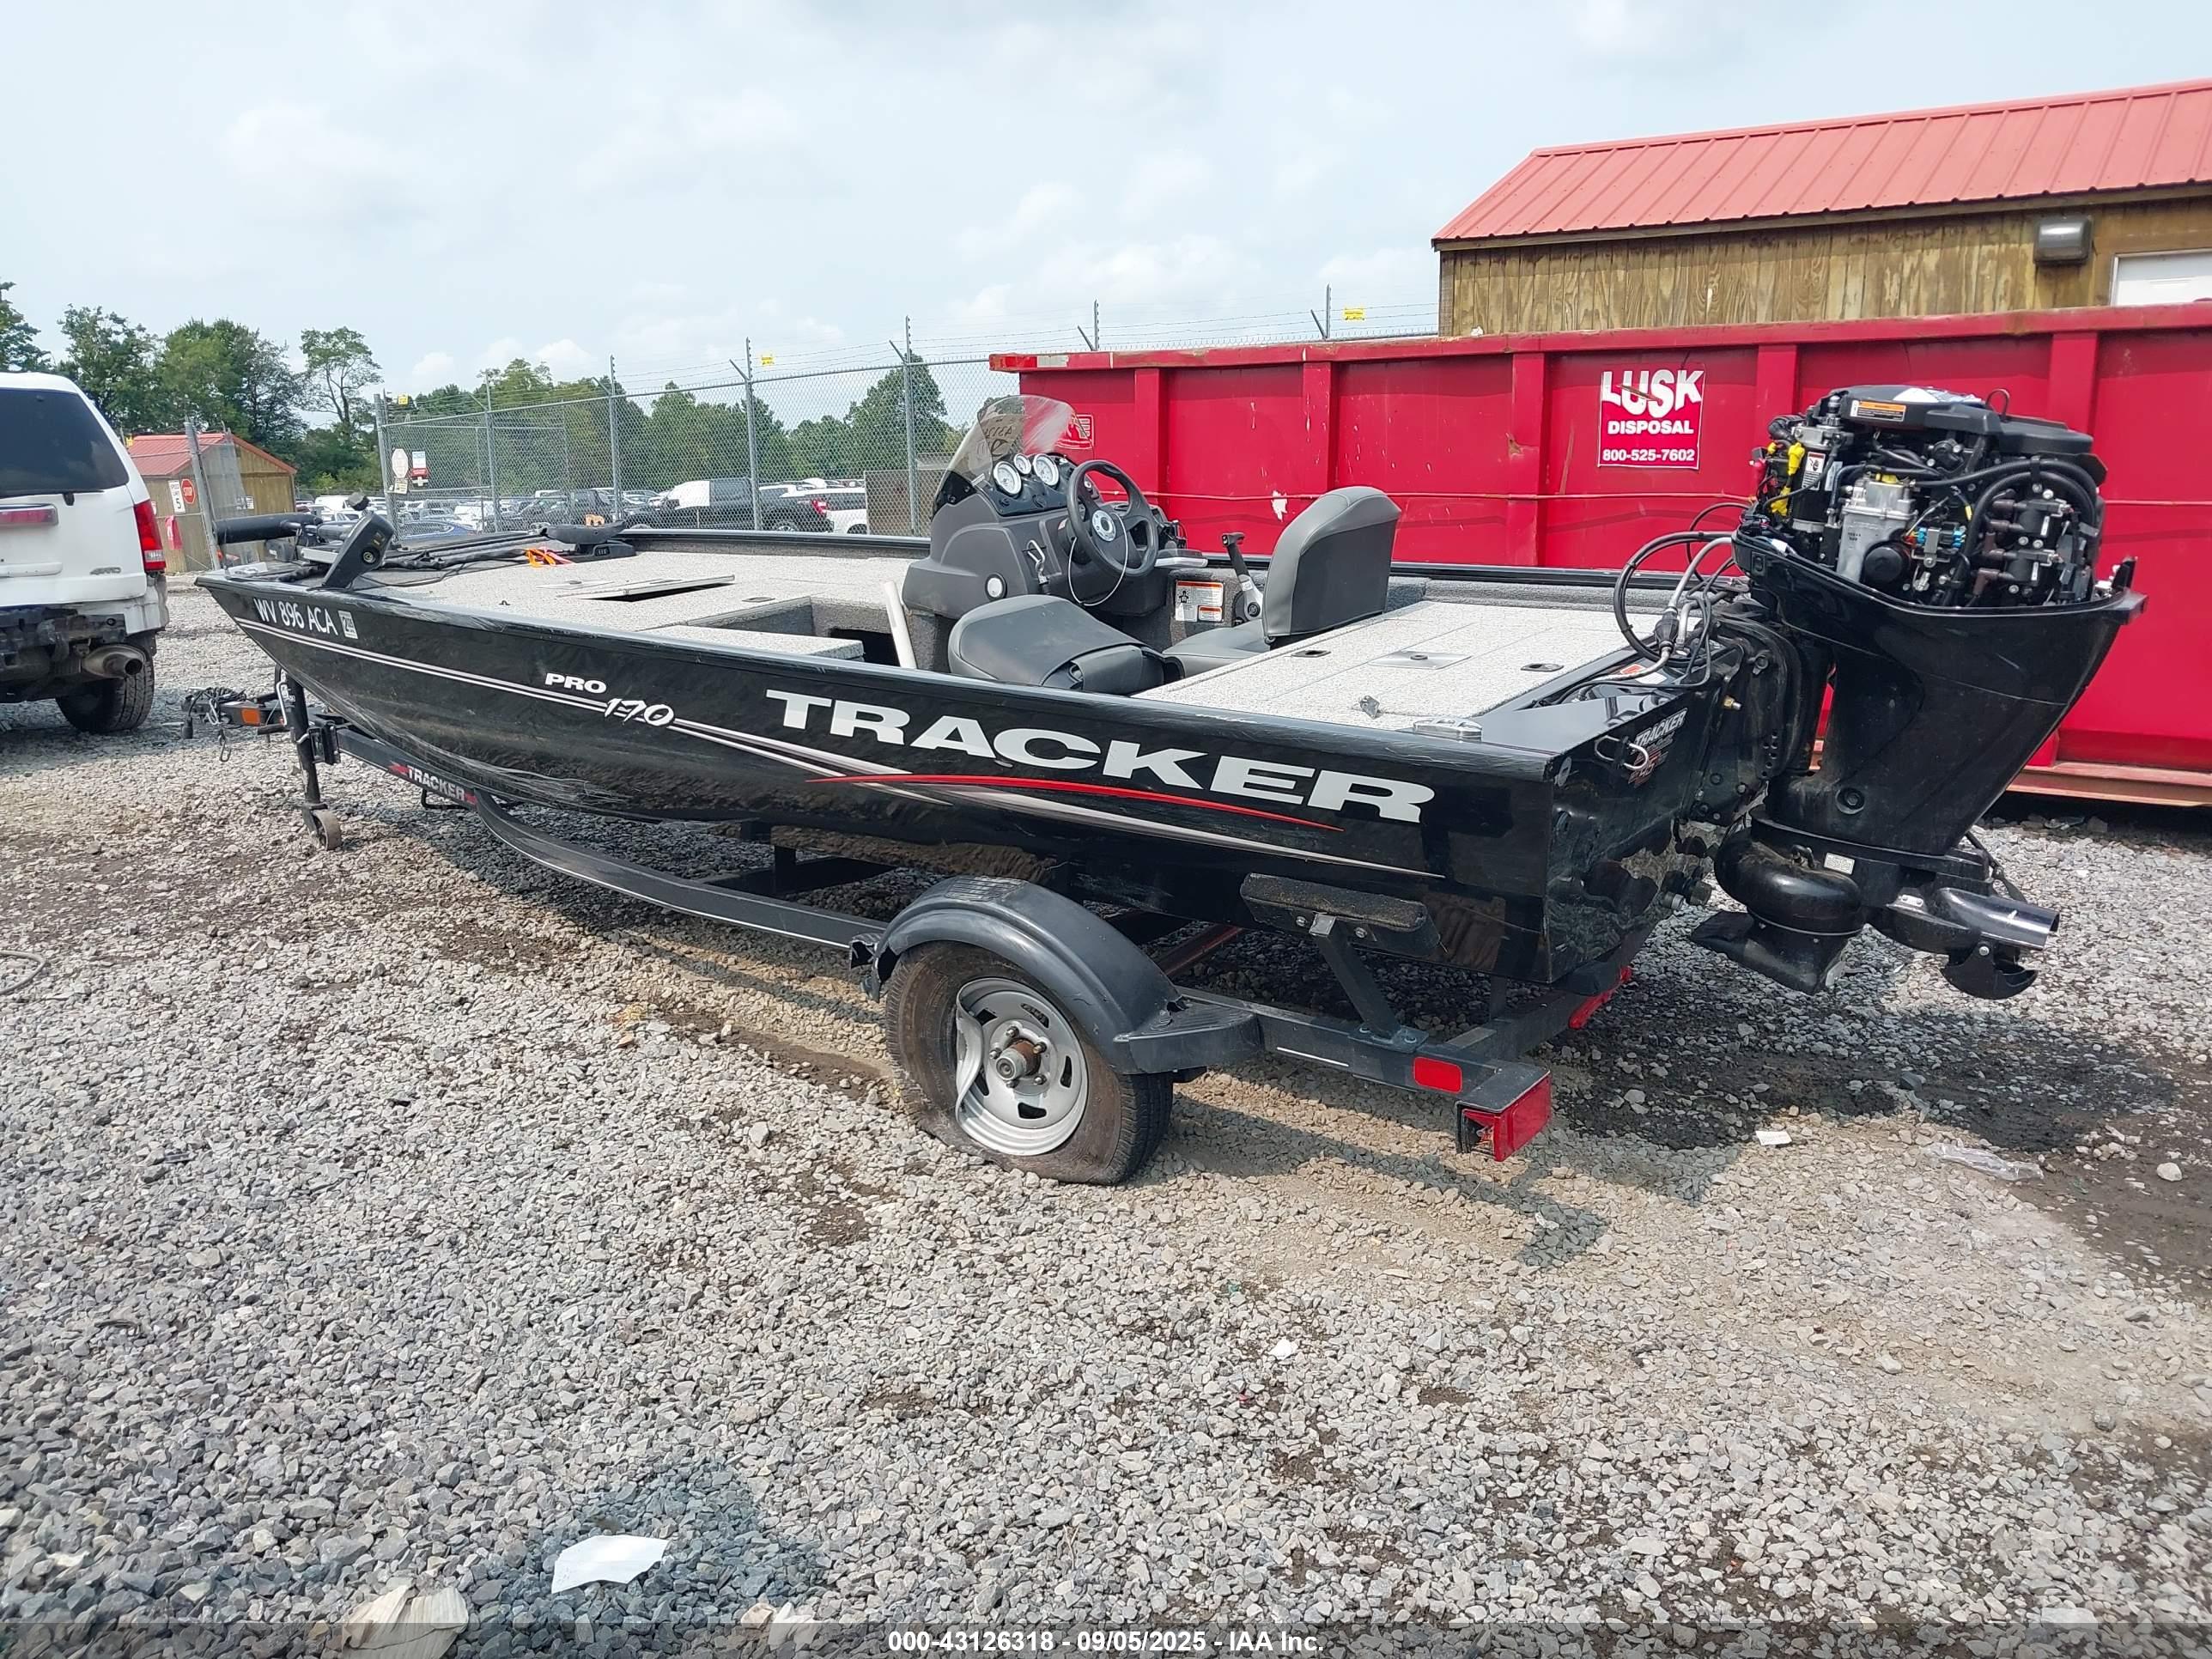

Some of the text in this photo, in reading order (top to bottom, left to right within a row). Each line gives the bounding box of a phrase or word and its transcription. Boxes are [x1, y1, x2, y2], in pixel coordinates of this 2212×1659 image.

[1601, 369, 1704, 418] LUSK
[1607, 420, 1694, 434] DISPOSAL
[1602, 448, 1695, 462] 800-525-7602
[175, 498, 182, 509] 5
[253, 598, 276, 623] WV
[278, 601, 305, 629] 896
[307, 605, 338, 635] ACA
[545, 672, 607, 694] PRO
[605, 698, 674, 726] 170
[1634, 708, 1687, 747] TRACKER
[765, 689, 1436, 823] TRACKER
[407, 764, 465, 801] TRACKER
